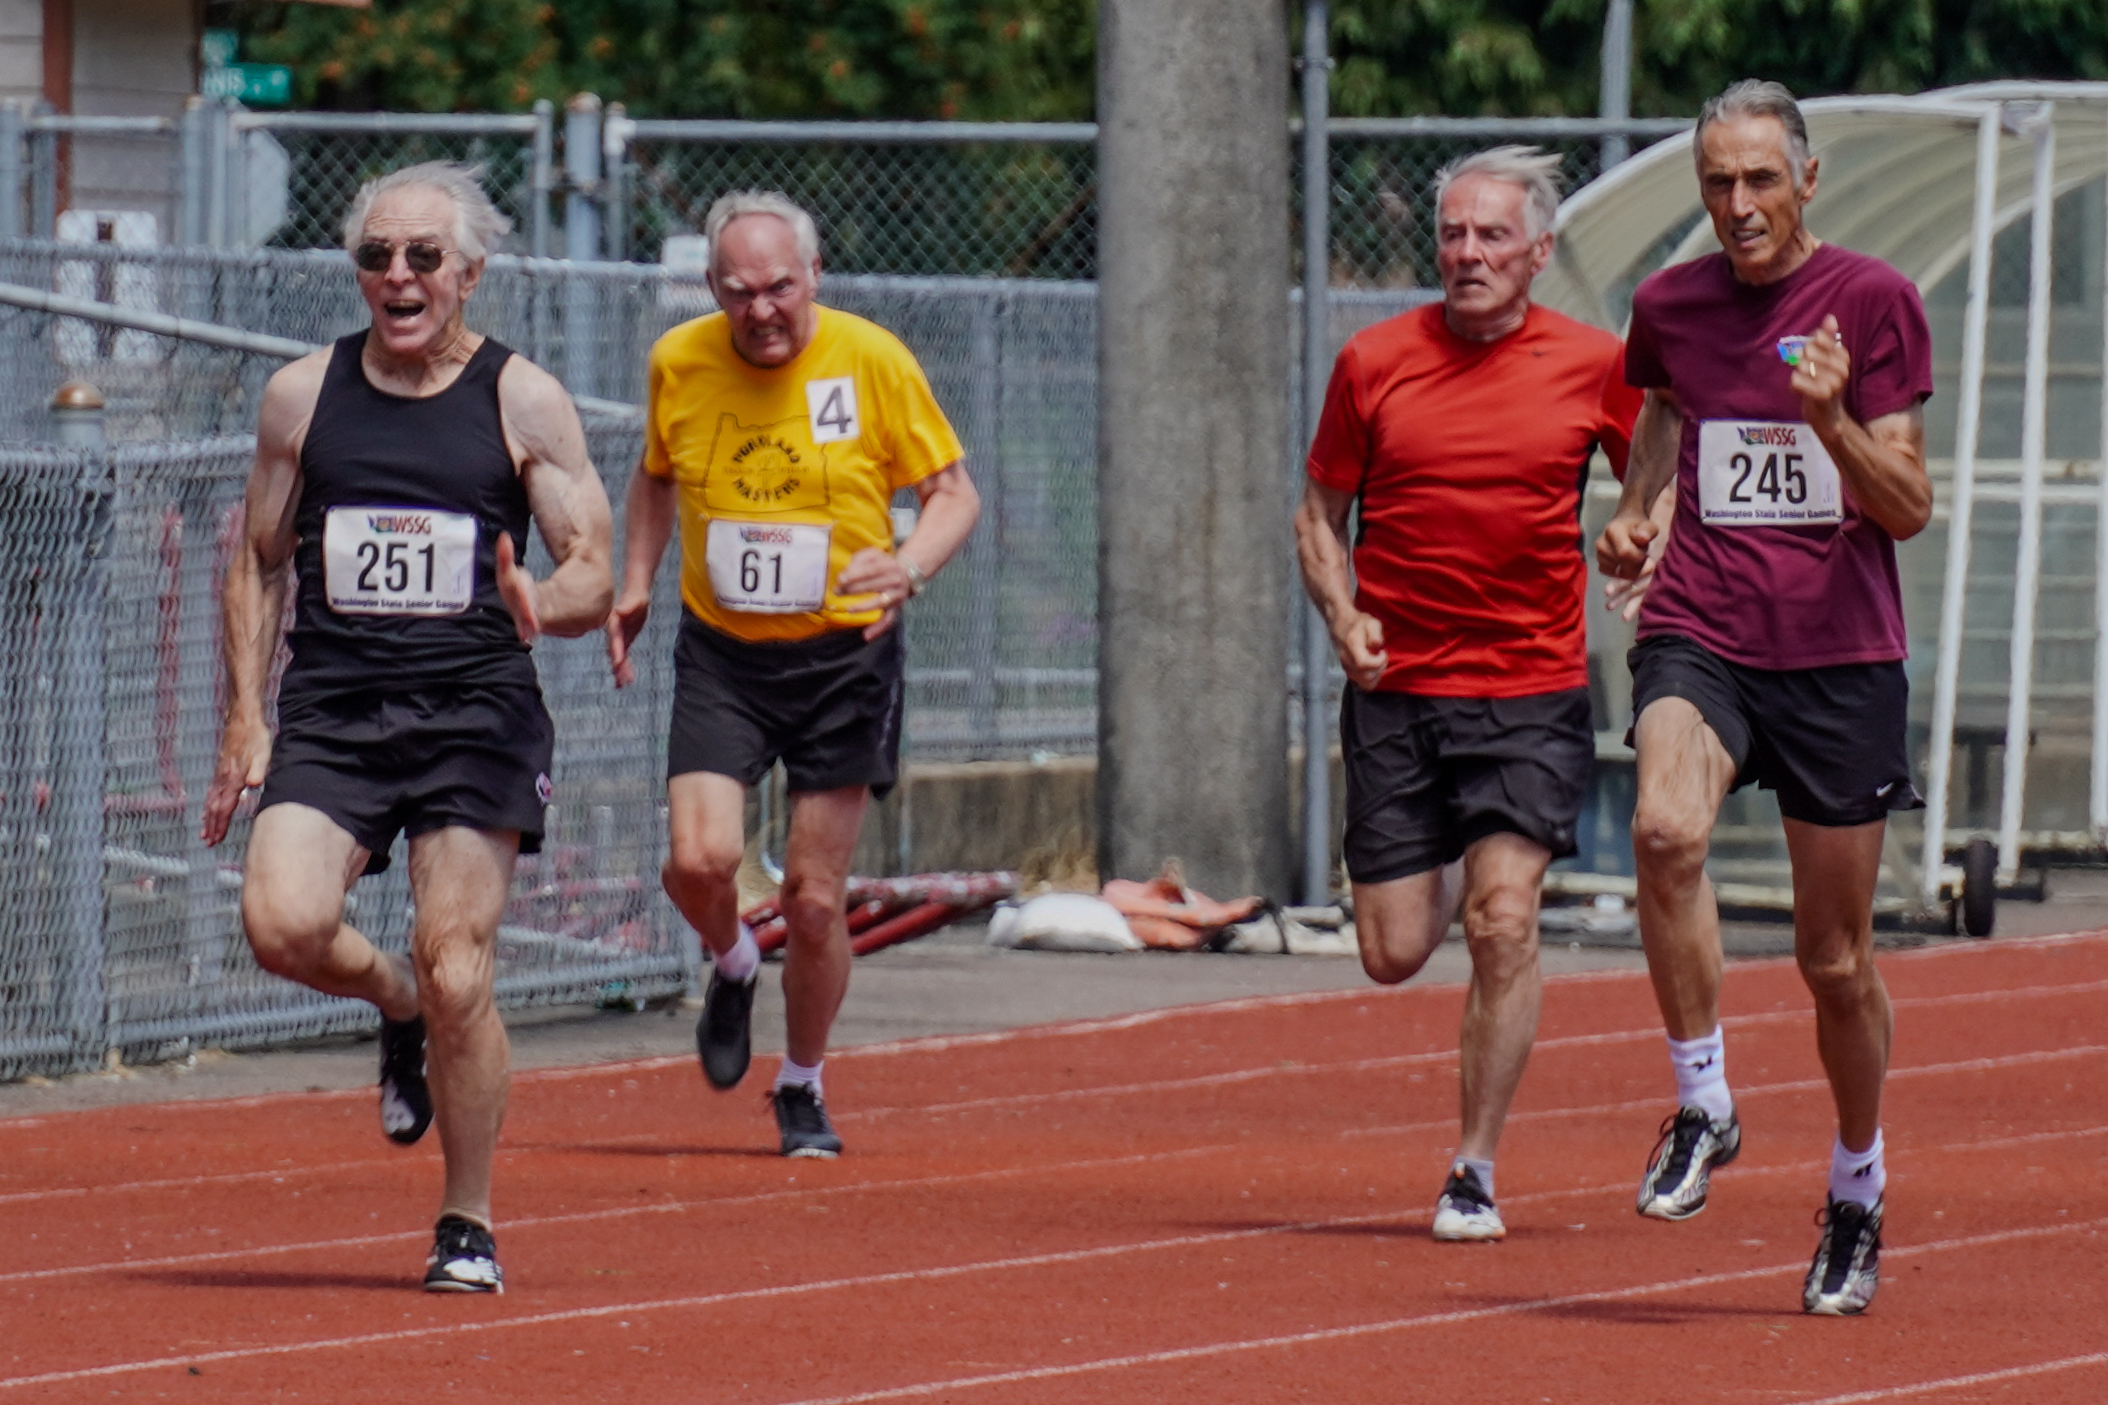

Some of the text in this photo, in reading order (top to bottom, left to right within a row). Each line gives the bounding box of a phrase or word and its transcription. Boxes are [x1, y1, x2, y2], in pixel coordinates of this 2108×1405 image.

[816, 385, 852, 434] 4
[1763, 427, 1797, 446] WSSG
[1729, 452, 1807, 504] 245
[393, 514, 432, 535] WSSG
[356, 540, 435, 593] 251
[741, 550, 782, 594] 61
